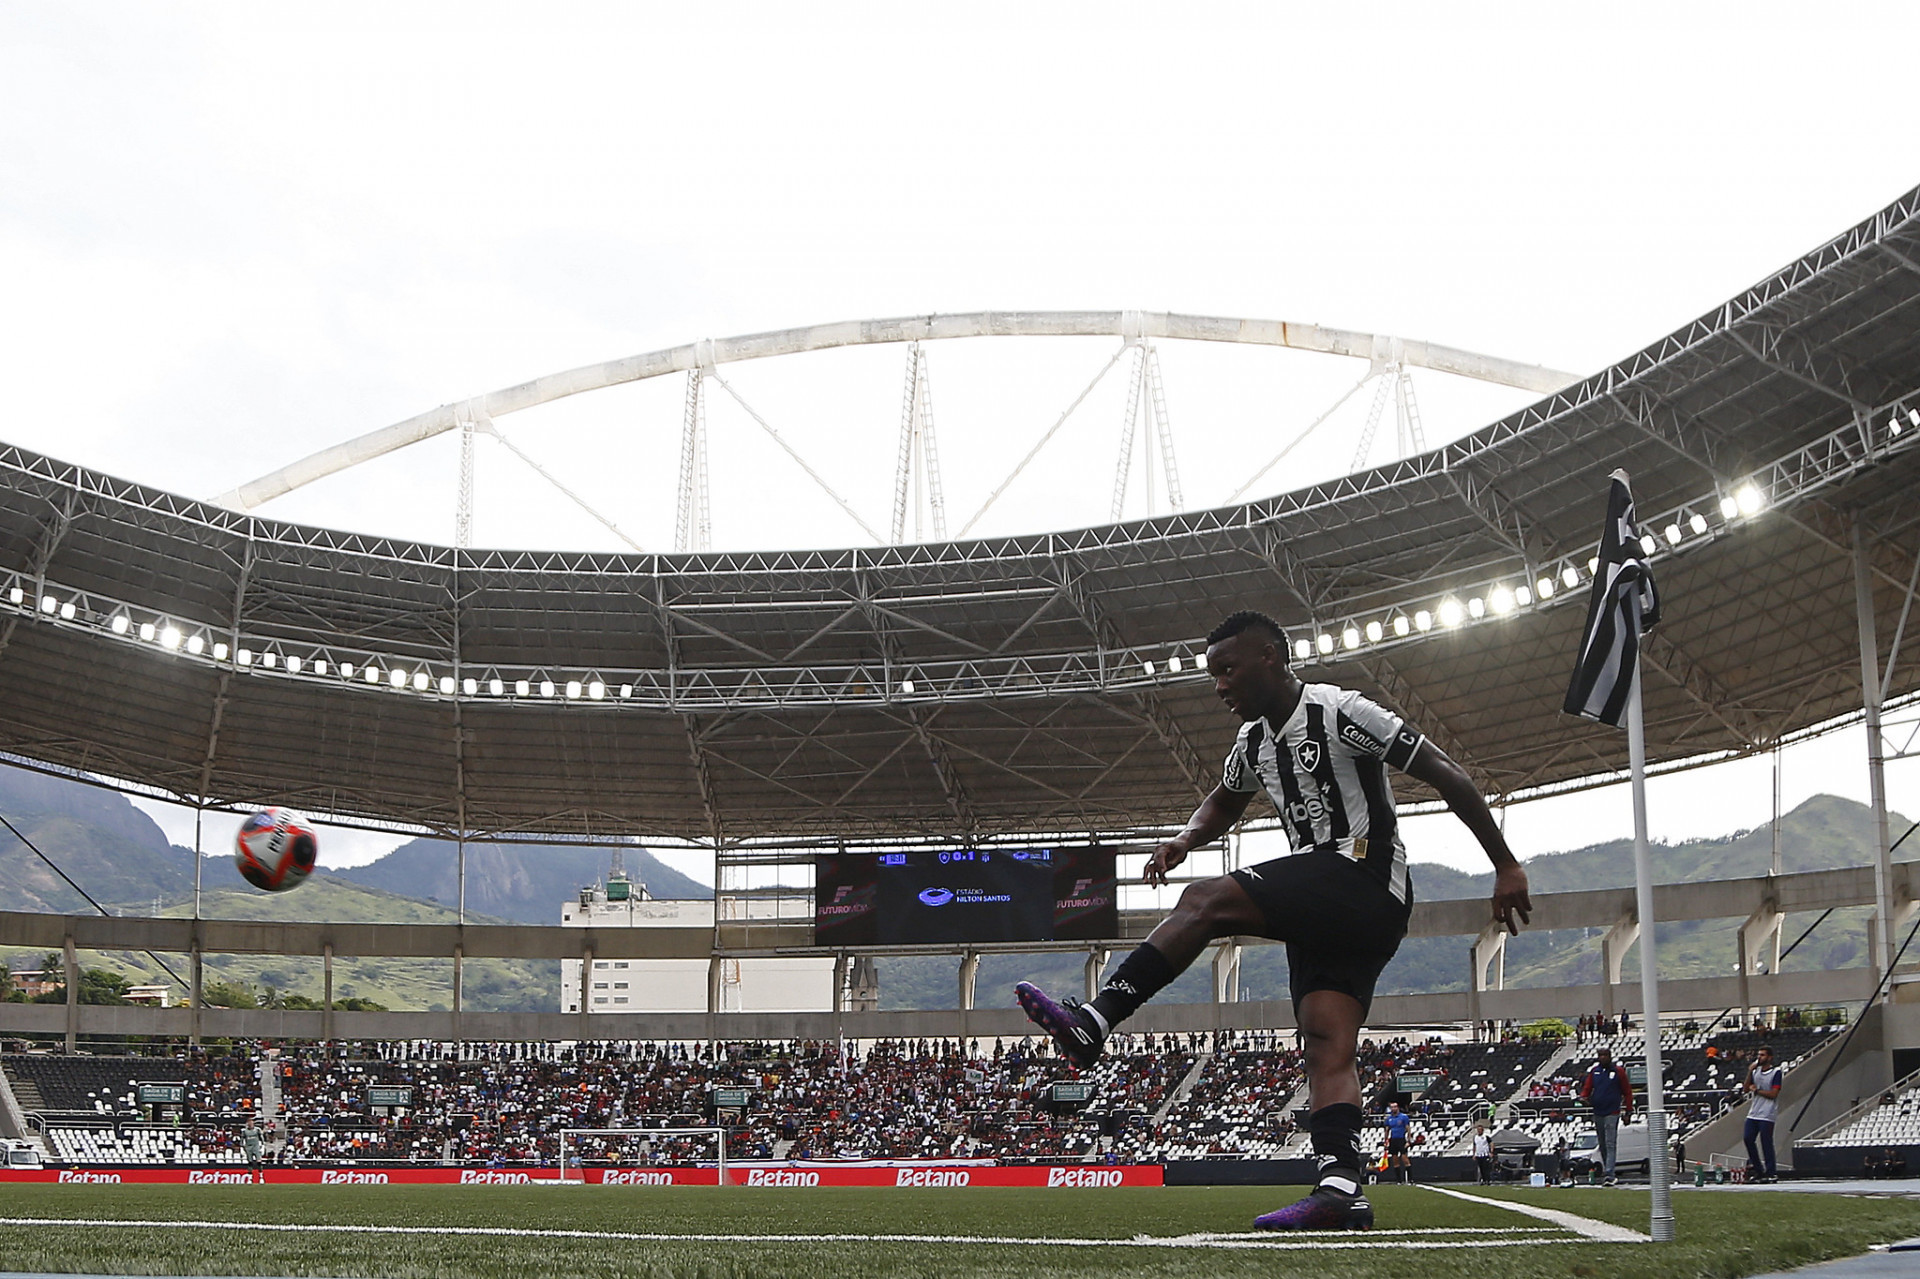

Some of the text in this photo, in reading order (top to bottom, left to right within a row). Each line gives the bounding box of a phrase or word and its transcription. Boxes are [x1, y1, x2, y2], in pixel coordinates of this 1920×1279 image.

[956, 894, 1011, 903] NILTON SANTOS
[58, 1170, 122, 1184] Betano
[321, 1170, 389, 1184] Betano
[460, 1169, 529, 1184] Betano
[602, 1169, 673, 1185] Betano
[747, 1169, 820, 1187] Betano
[896, 1168, 970, 1187] Betano
[1047, 1167, 1123, 1188] Betano
